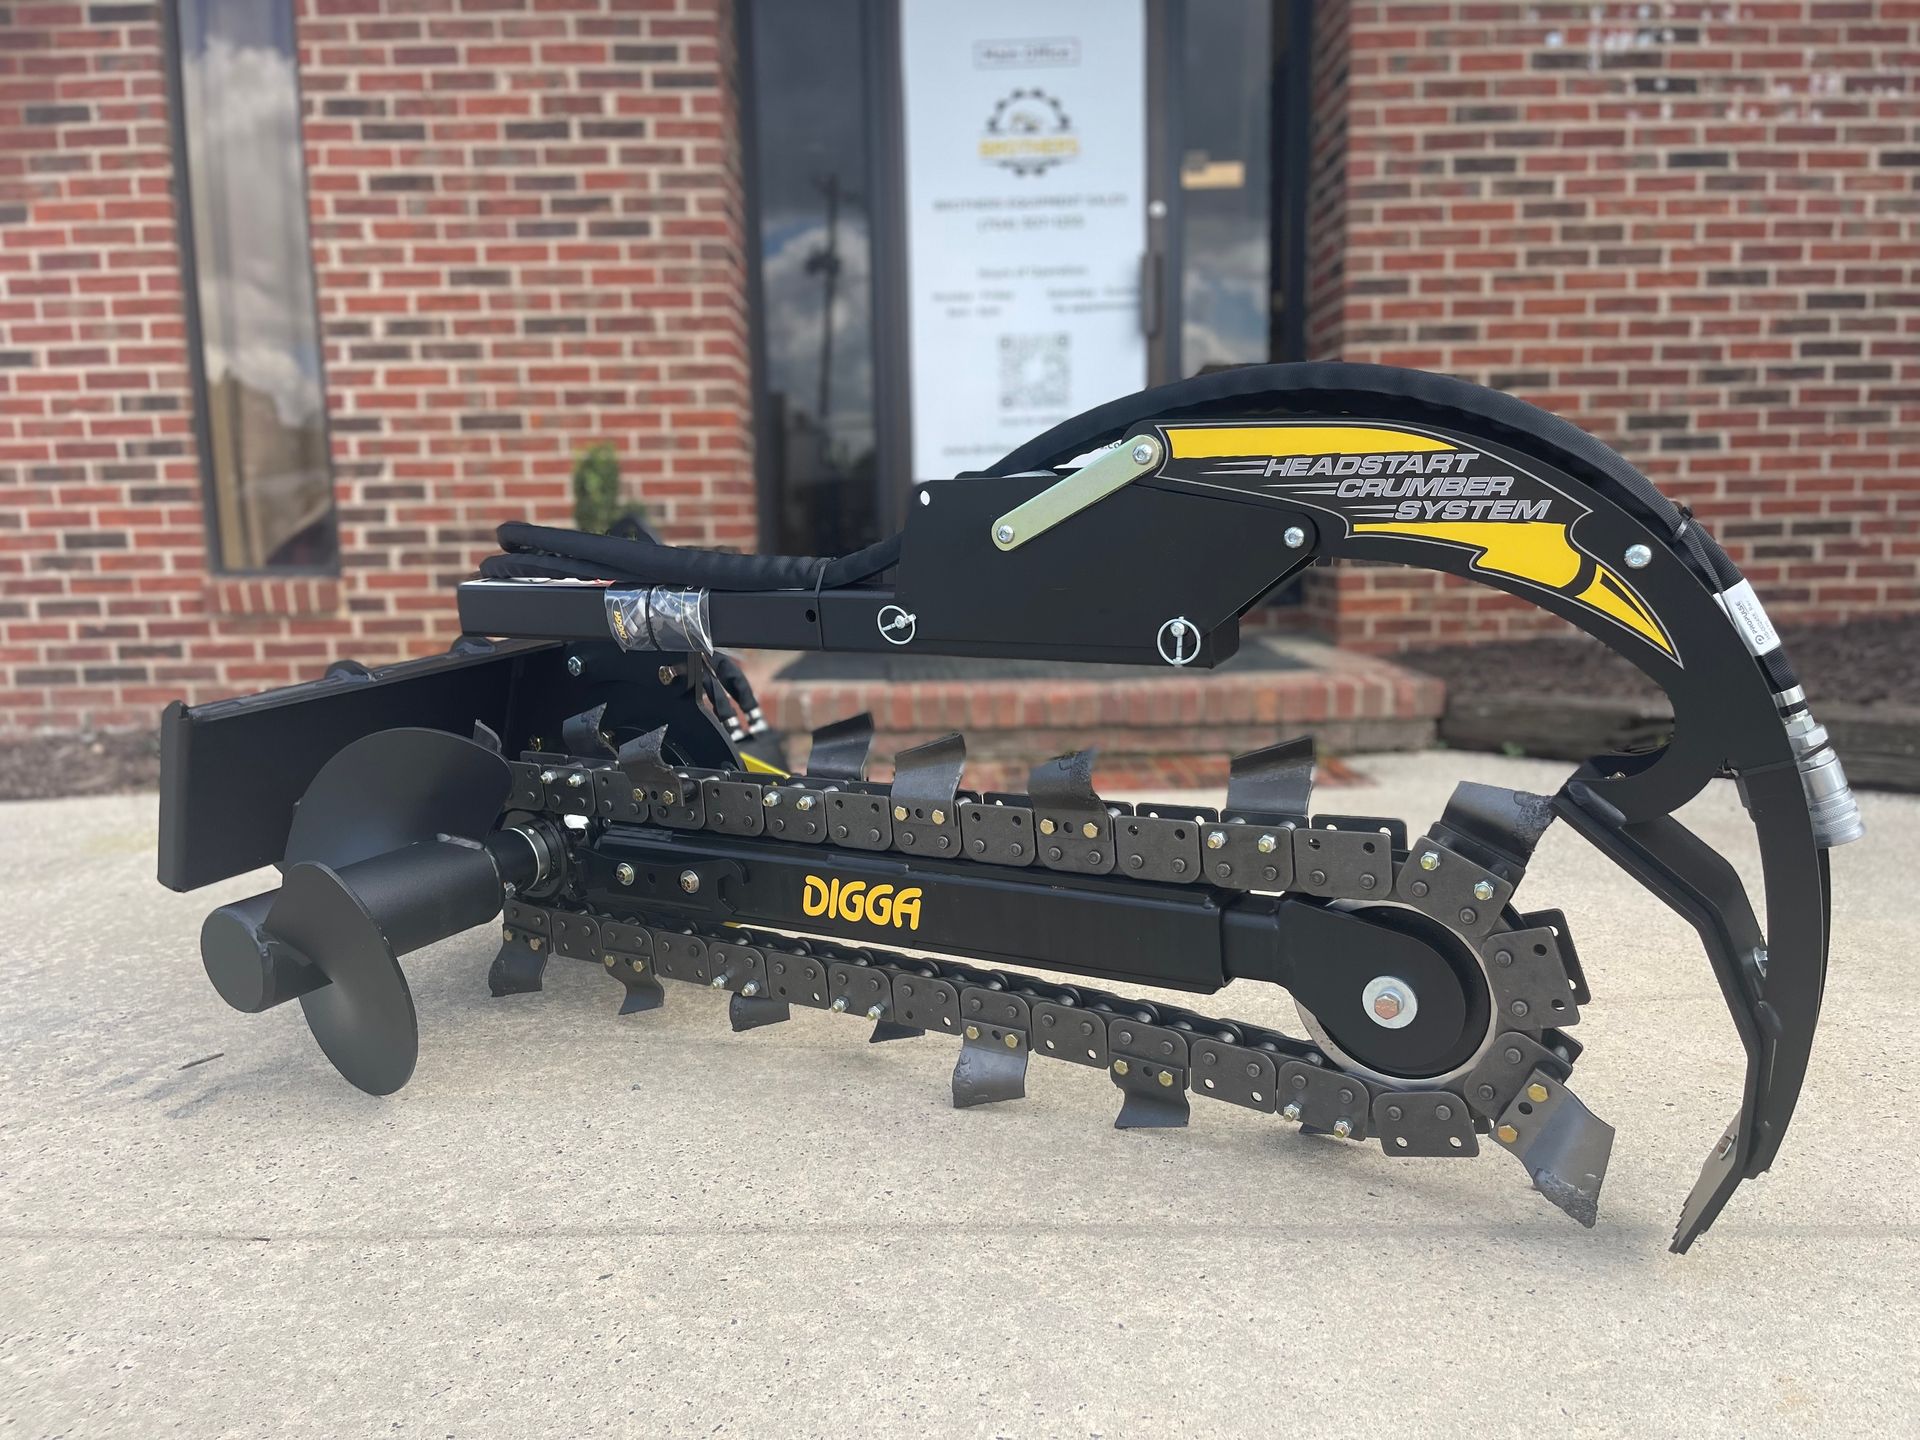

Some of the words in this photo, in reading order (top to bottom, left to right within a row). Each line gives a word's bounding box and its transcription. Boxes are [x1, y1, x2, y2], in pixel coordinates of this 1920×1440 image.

[1263, 453, 1479, 477] HEADSTART
[1336, 476, 1514, 497] CRUMBER
[1393, 499, 1552, 520] SYSTEM
[613, 610, 628, 639] DIGGA
[1735, 601, 1758, 635] PROPULSE
[803, 874, 923, 931] DIGGA
